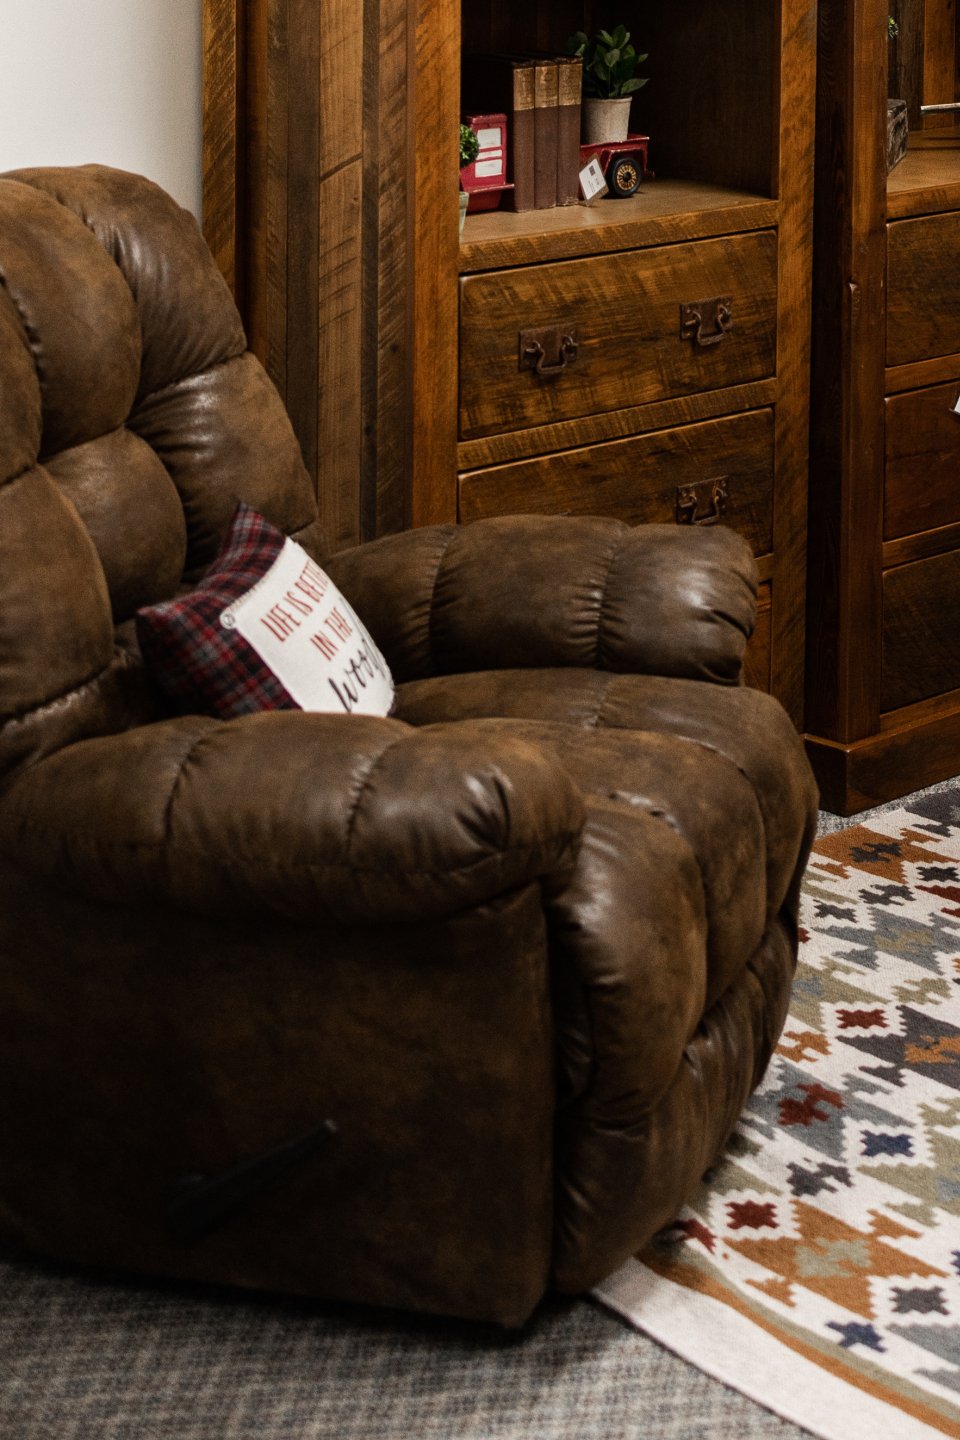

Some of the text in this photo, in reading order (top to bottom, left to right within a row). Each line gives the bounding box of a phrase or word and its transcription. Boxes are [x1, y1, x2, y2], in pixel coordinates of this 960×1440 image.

[259, 560, 330, 643] LIFE IS BETTE
[309, 607, 354, 662] IN THE
